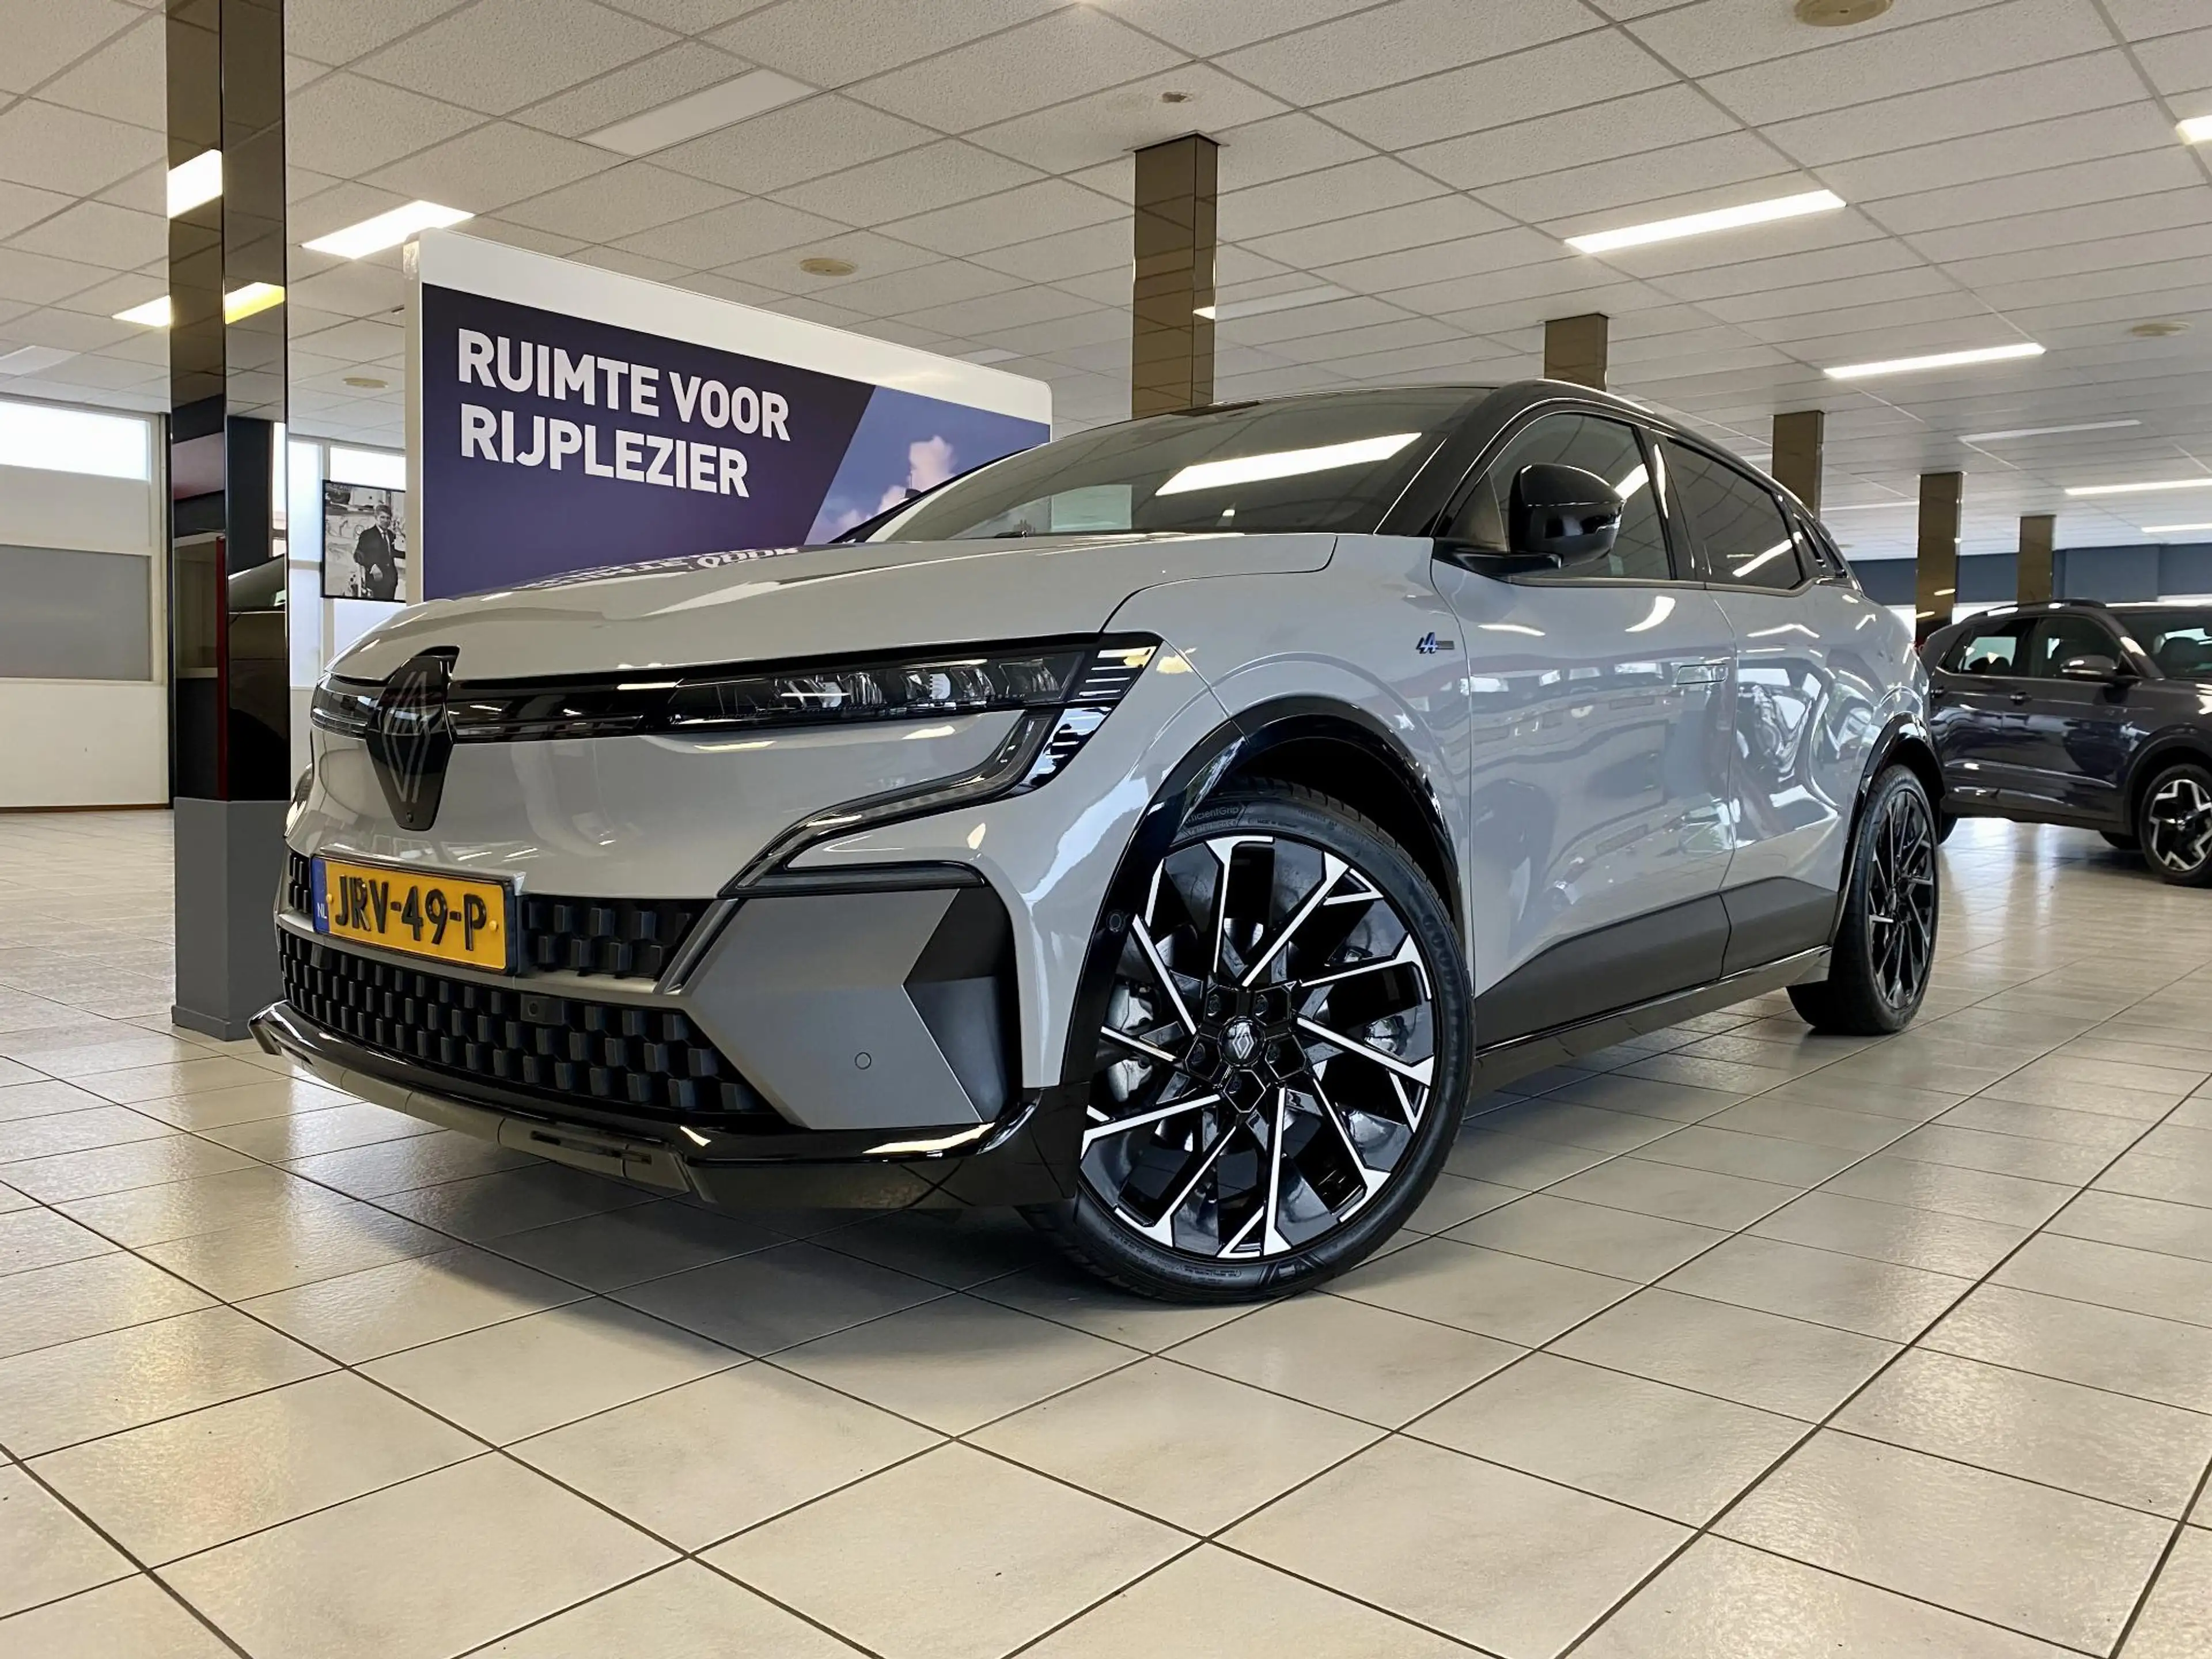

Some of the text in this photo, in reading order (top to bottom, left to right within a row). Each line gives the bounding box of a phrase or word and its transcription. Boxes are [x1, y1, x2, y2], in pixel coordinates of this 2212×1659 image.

[459, 328, 790, 441] RUIMTE VOOR
[461, 403, 749, 498] RIJPLEZIER
[316, 902, 328, 919] NL
[335, 875, 487, 951] JRV-49-P
